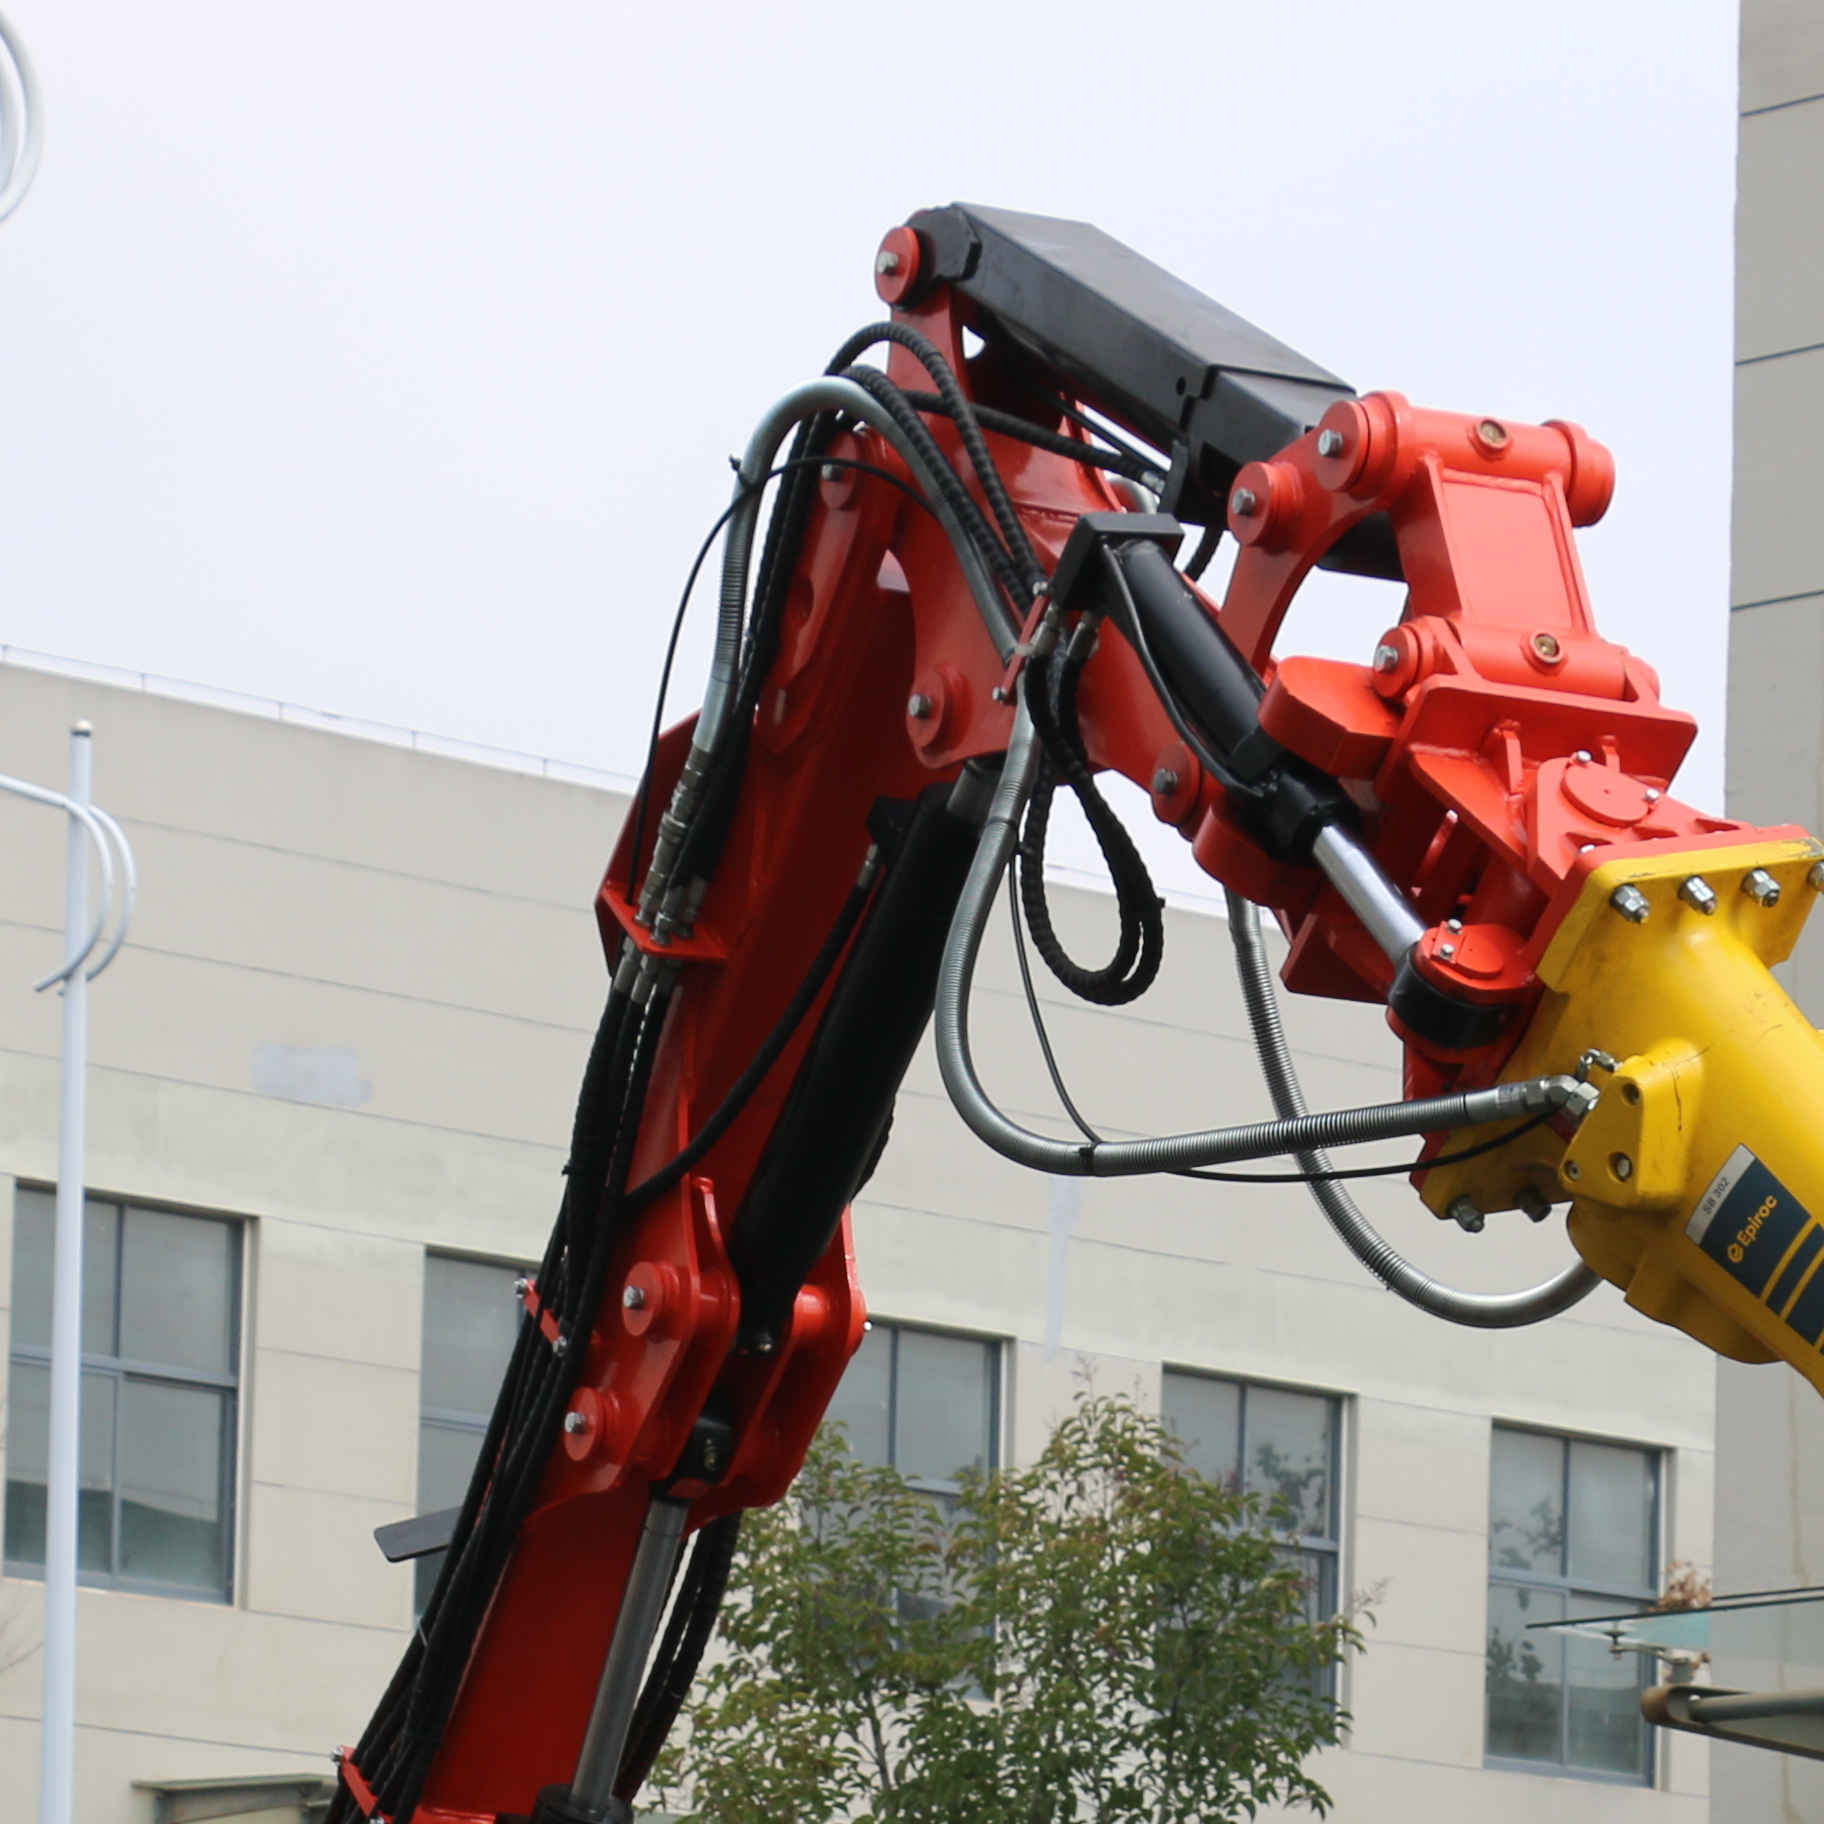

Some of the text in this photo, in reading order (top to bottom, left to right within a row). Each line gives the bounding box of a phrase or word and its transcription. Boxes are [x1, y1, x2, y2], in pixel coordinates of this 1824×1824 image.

[1702, 1177, 1730, 1215] SB 302
[1736, 1195, 1778, 1247] Epiroc
